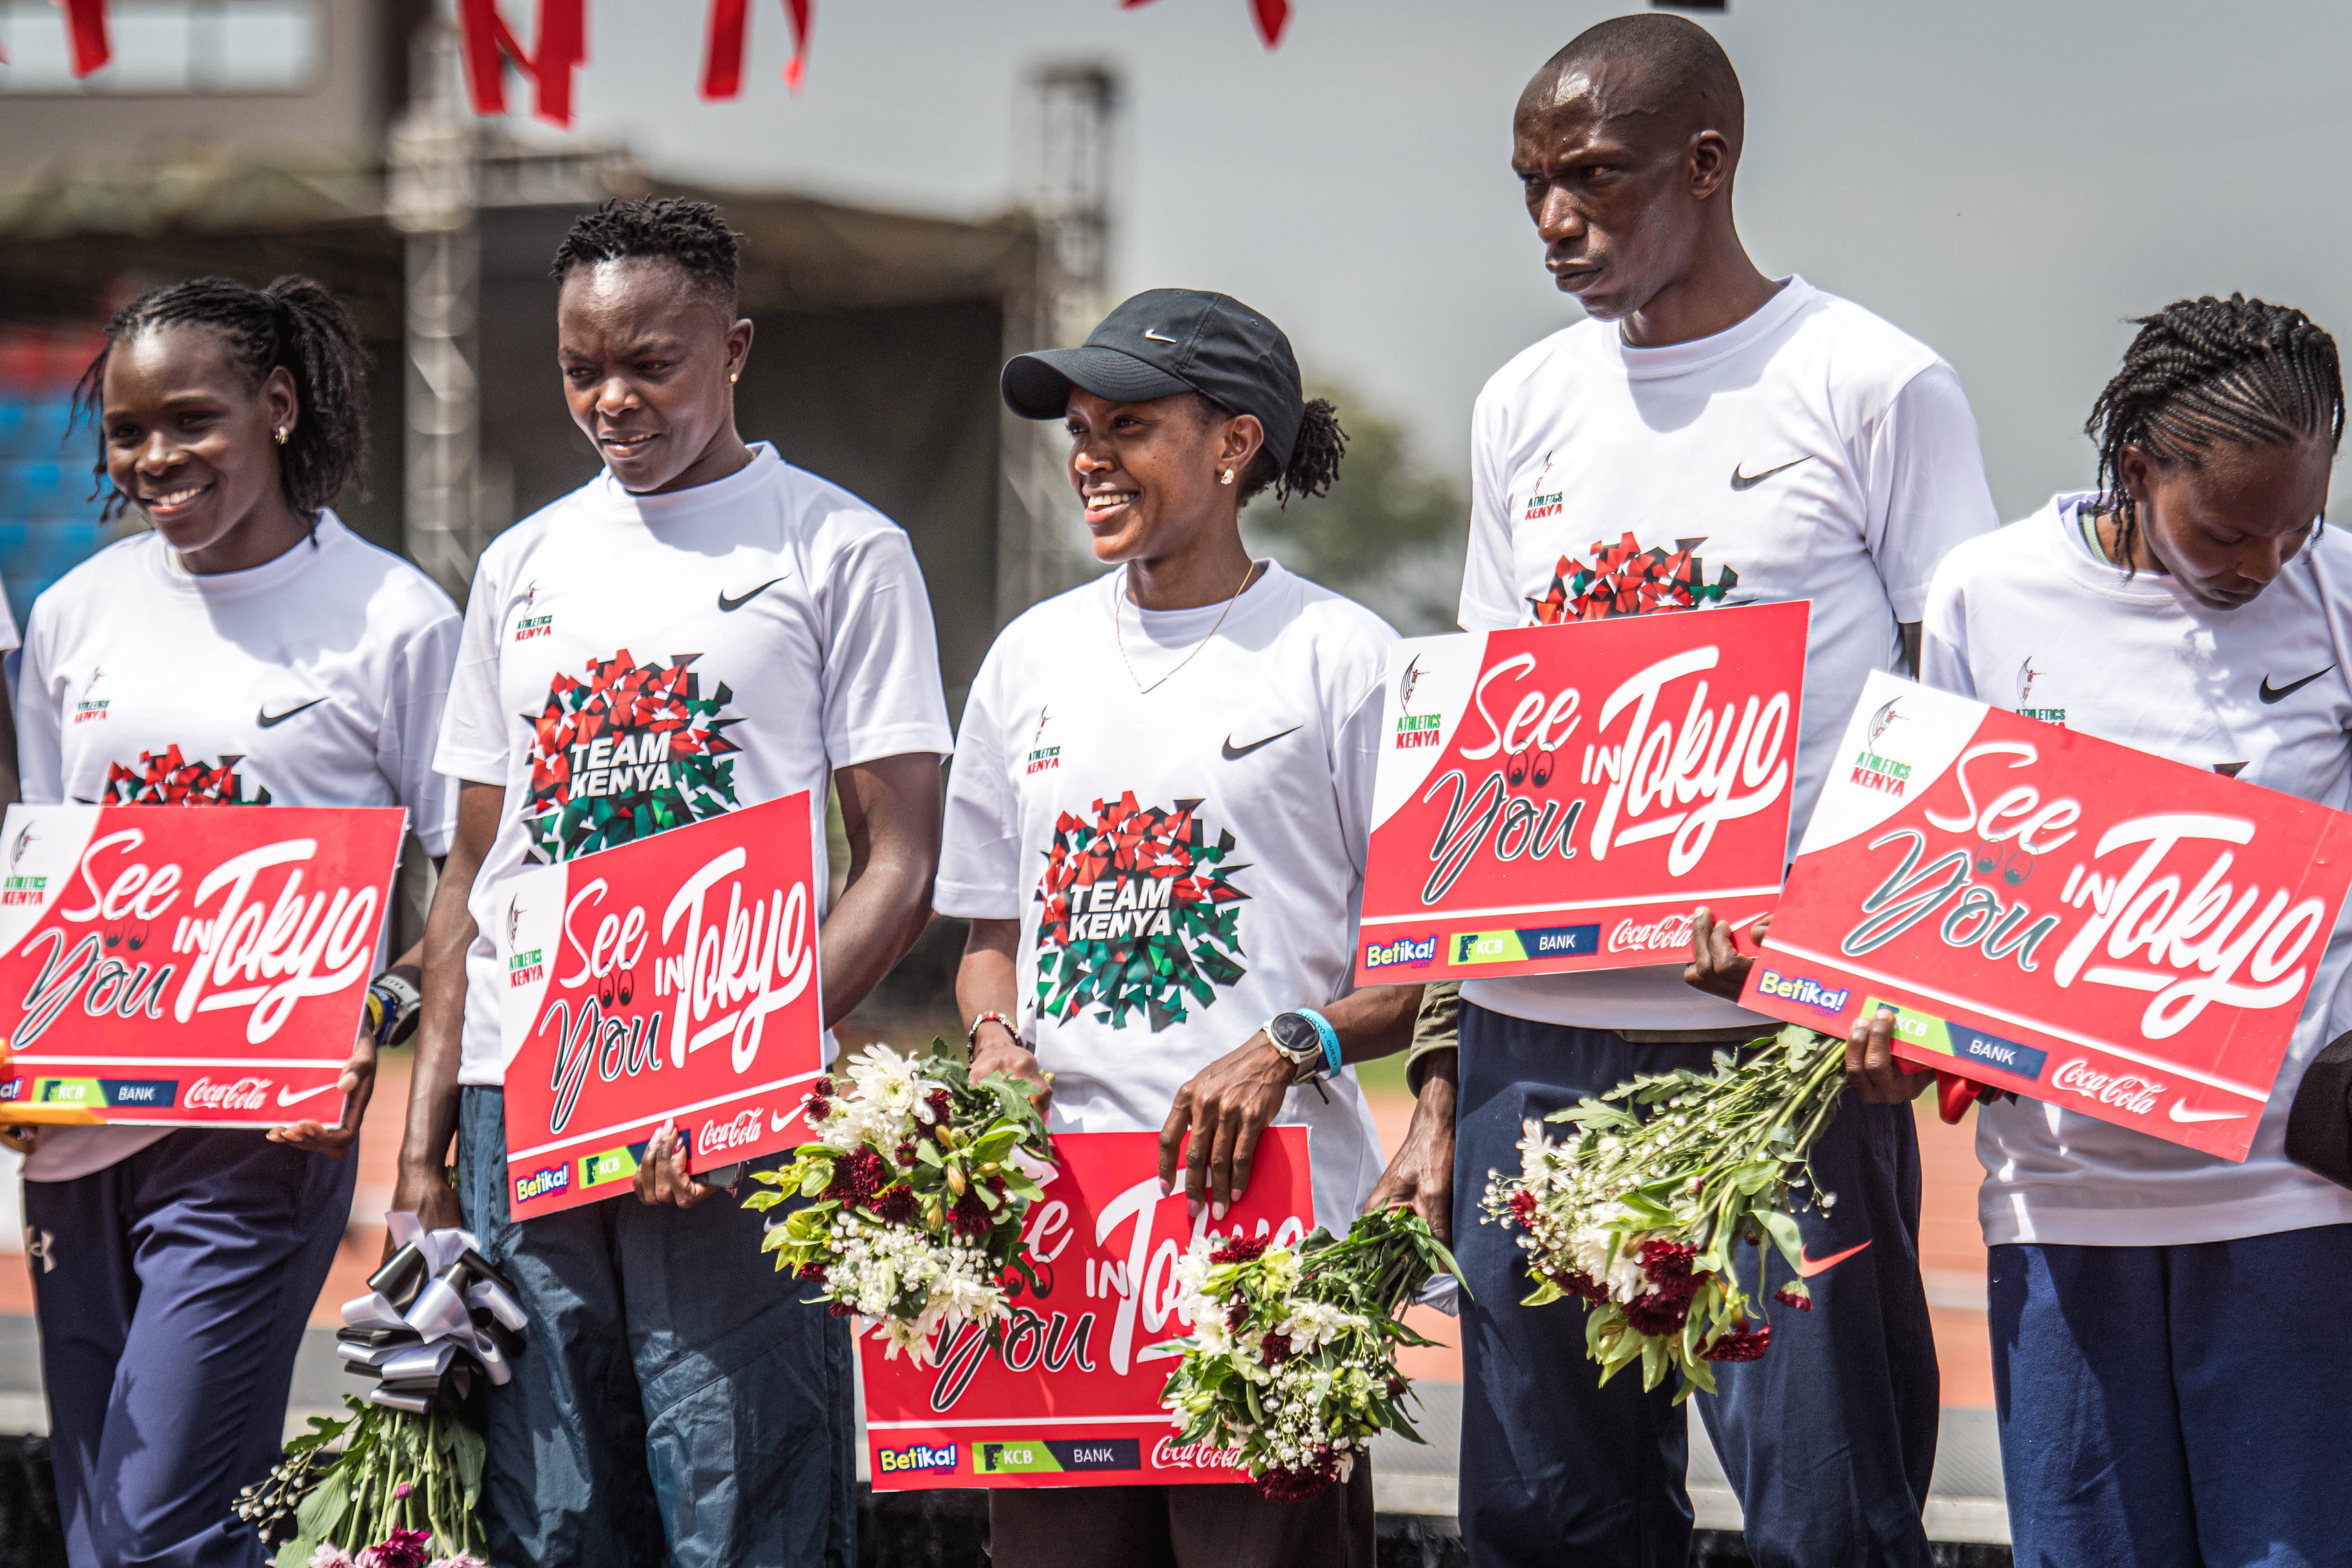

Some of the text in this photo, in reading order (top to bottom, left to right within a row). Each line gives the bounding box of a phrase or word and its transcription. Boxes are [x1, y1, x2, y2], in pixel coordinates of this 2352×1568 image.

[1524, 503, 1562, 520] KENYA
[515, 625, 551, 642] KENYA
[516, 615, 552, 630] ATHLETICS
[75, 710, 106, 724] KENYA
[1396, 714, 1441, 732] ATHLETICS
[1460, 653, 1582, 761] See
[569, 731, 672, 773] TEAM
[1028, 746, 1060, 762] ATHLETICS
[1396, 730, 1440, 749] KENYA
[1027, 758, 1059, 775] KENYA
[1581, 646, 1789, 877] IN Tokyo
[1854, 751, 1911, 780] ATHLETICS
[568, 762, 671, 801] KENYA
[1850, 766, 1905, 797] KENYA
[1925, 742, 2081, 854] See
[1421, 769, 1585, 905] You
[60, 828, 182, 924] See
[1, 891, 43, 906] KENYA
[1070, 877, 1174, 913] TEAM
[1841, 830, 2061, 972] You
[172, 838, 379, 1044] IN Tokyo
[559, 877, 649, 988] See
[1068, 909, 1171, 941] KENYA
[1608, 914, 1694, 952] Coca-Cola
[2053, 813, 2326, 1039] IN Tokyo
[509, 948, 542, 971] ATHLETICS
[655, 846, 812, 1074] IN Tokyo
[1367, 936, 1436, 968] Betika!
[1476, 934, 1575, 955] KCB BANK
[10, 926, 176, 1050] You
[511, 965, 543, 988] KENYA
[1759, 969, 1849, 1012] Betika!
[1326, 1039, 1337, 1066] GUEST
[1894, 1015, 2016, 1065] KCB BANK
[538, 995, 662, 1134] You
[58, 1084, 156, 1101] KCB BANK
[184, 1076, 273, 1109] Coca-Cola
[2052, 1060, 2167, 1114] Coca-Cola
[698, 1107, 764, 1155] Coca-Cola
[516, 1163, 569, 1202] Betika!
[599, 1157, 620, 1176] KCB
[1086, 1259, 1130, 1300] IN
[881, 1443, 955, 1471] Betika!
[1004, 1448, 1114, 1464] KCB BANK
